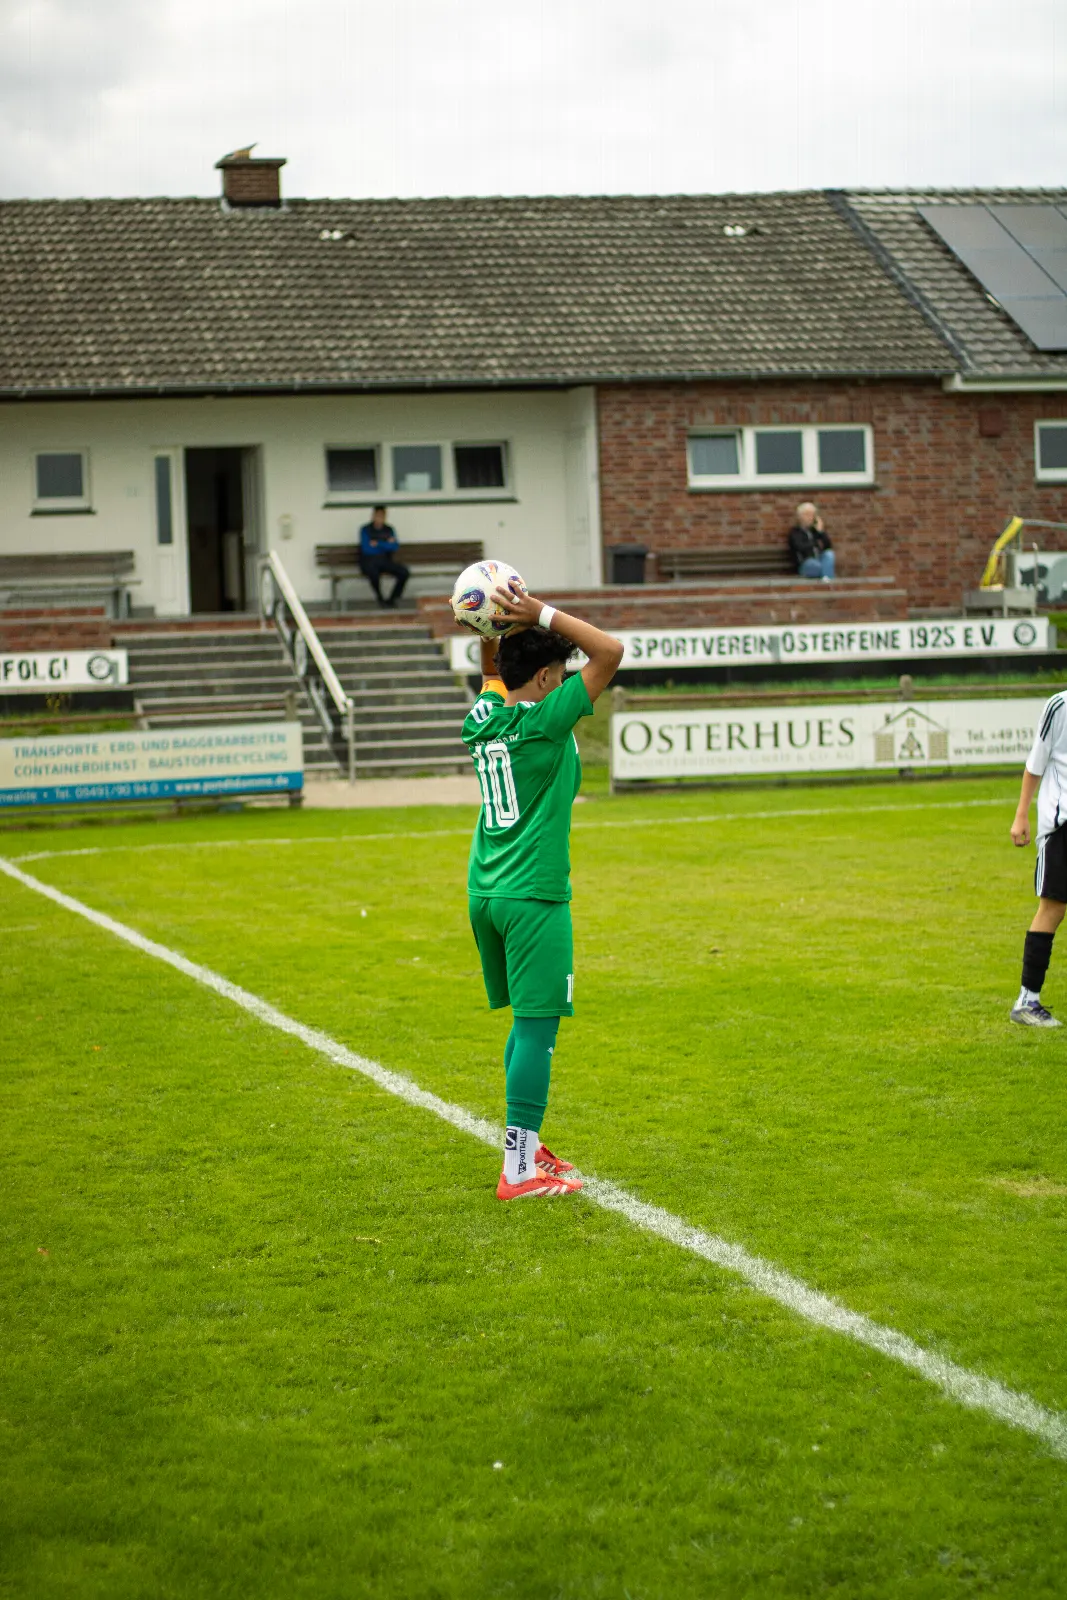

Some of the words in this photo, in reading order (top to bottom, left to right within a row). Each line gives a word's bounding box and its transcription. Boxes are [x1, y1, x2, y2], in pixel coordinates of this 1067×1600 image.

[631, 634, 770, 659] SPORTVEREIN
[782, 629, 900, 653] OSTERFEINE
[909, 625, 955, 648] 1925
[0, 657, 68, 681] FOLG!
[14, 741, 100, 759] TRANSPORTE
[141, 738, 170, 752] UND
[172, 732, 286, 749] BAGGERARBEITEN
[619, 717, 855, 756] OSTERHUES
[14, 758, 138, 777] CONTAINERDIENST
[148, 749, 288, 770] BAUSTOFFRECYCLING
[472, 742, 519, 828] 10
